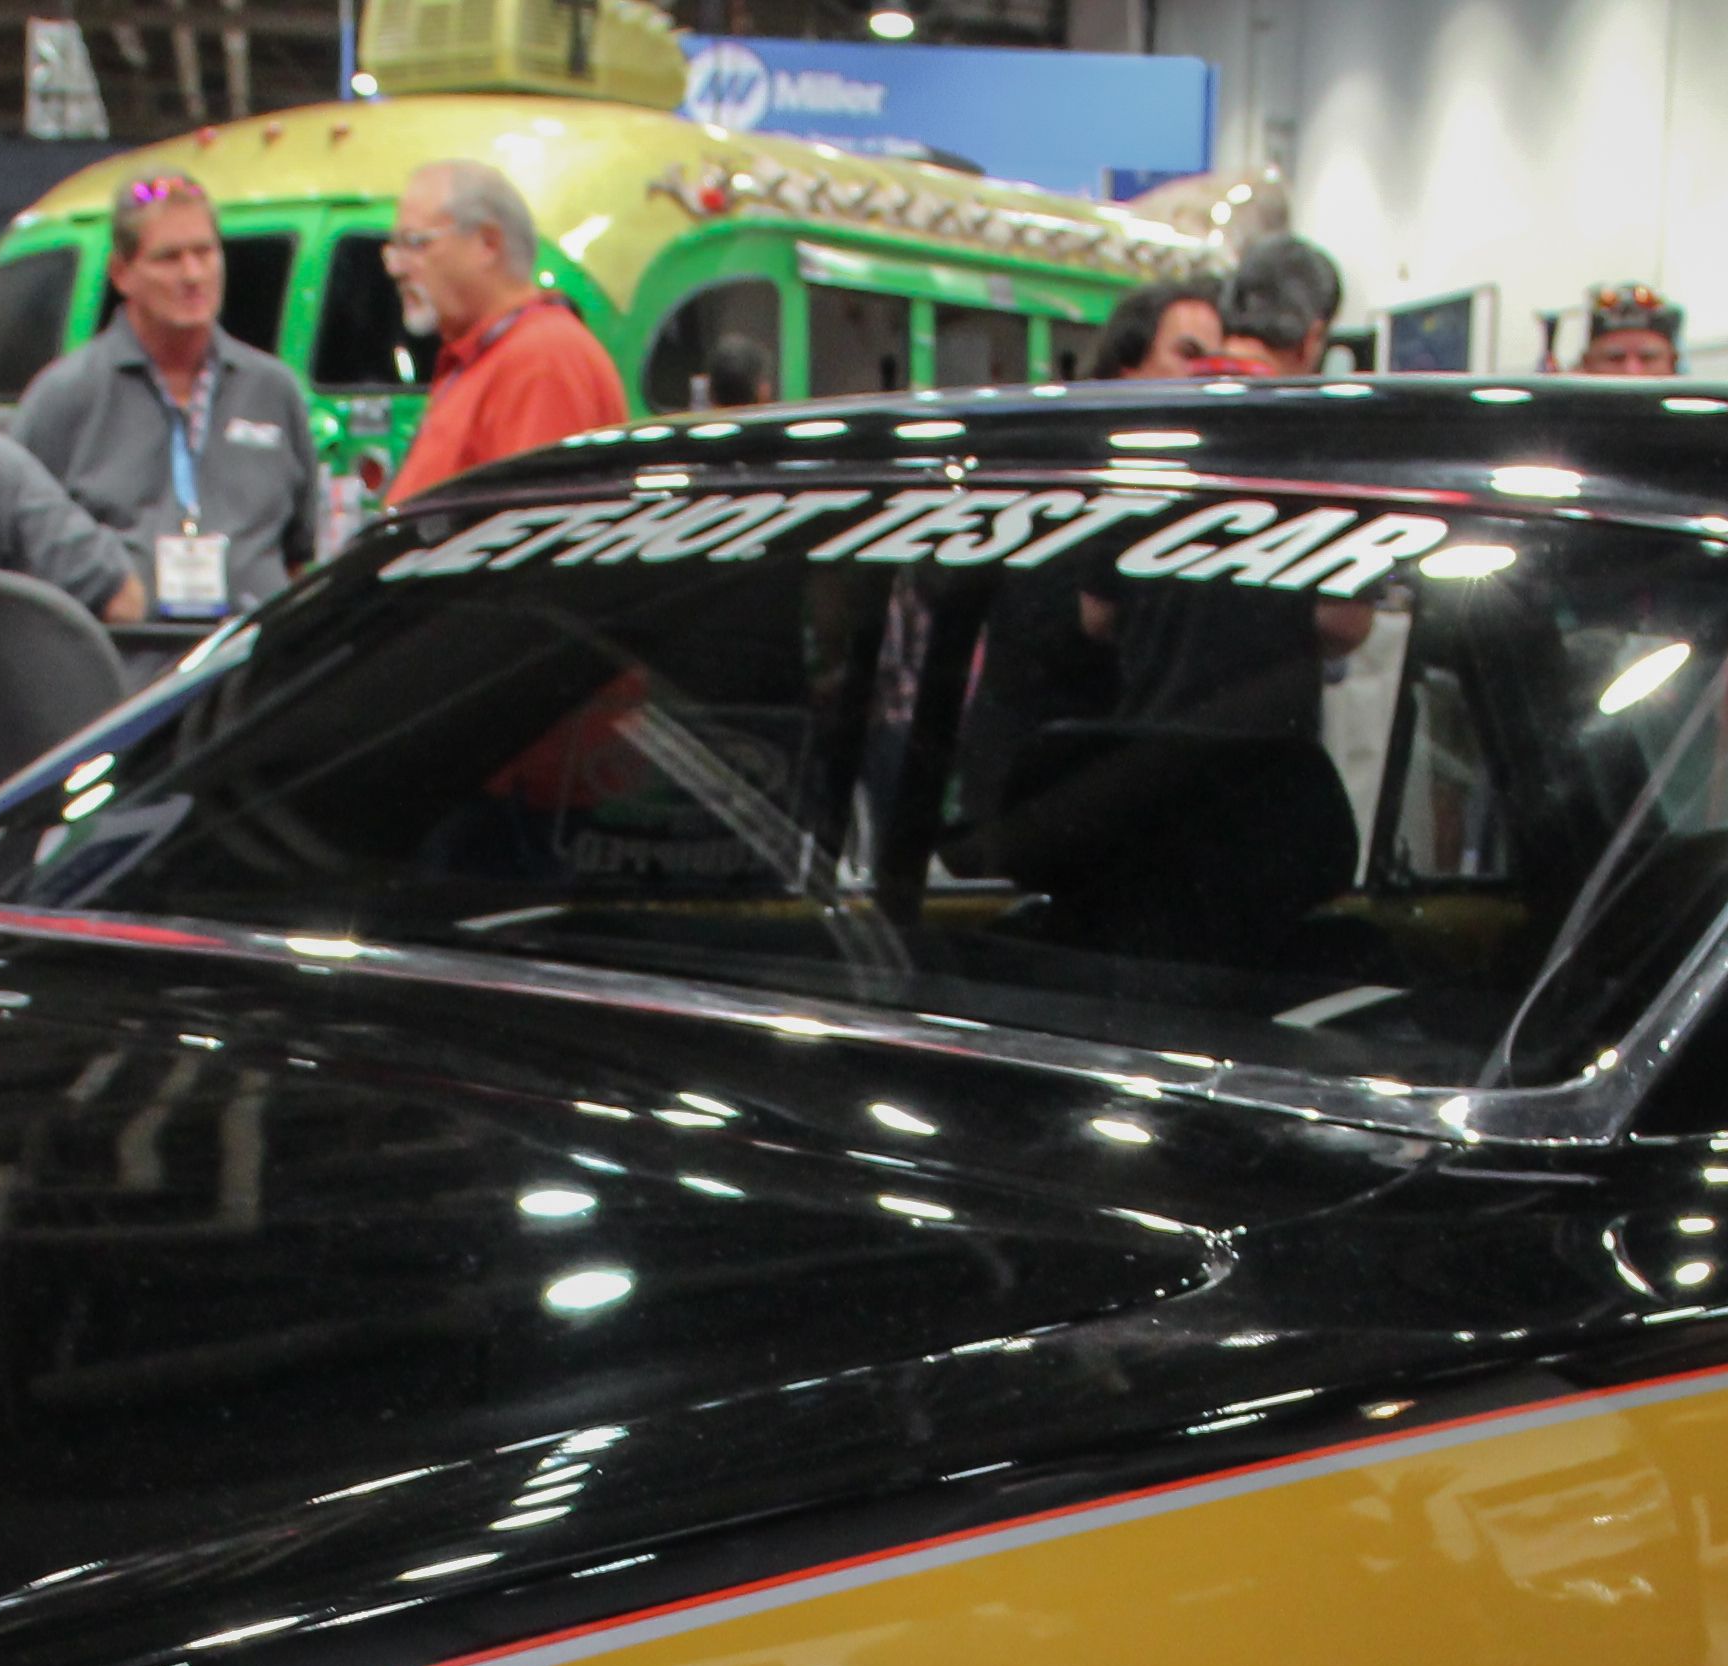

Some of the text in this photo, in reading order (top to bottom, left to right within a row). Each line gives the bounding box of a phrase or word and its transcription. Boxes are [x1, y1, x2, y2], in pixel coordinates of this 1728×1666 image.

[377, 490, 1450, 598] JET-HOT TEST CAR
